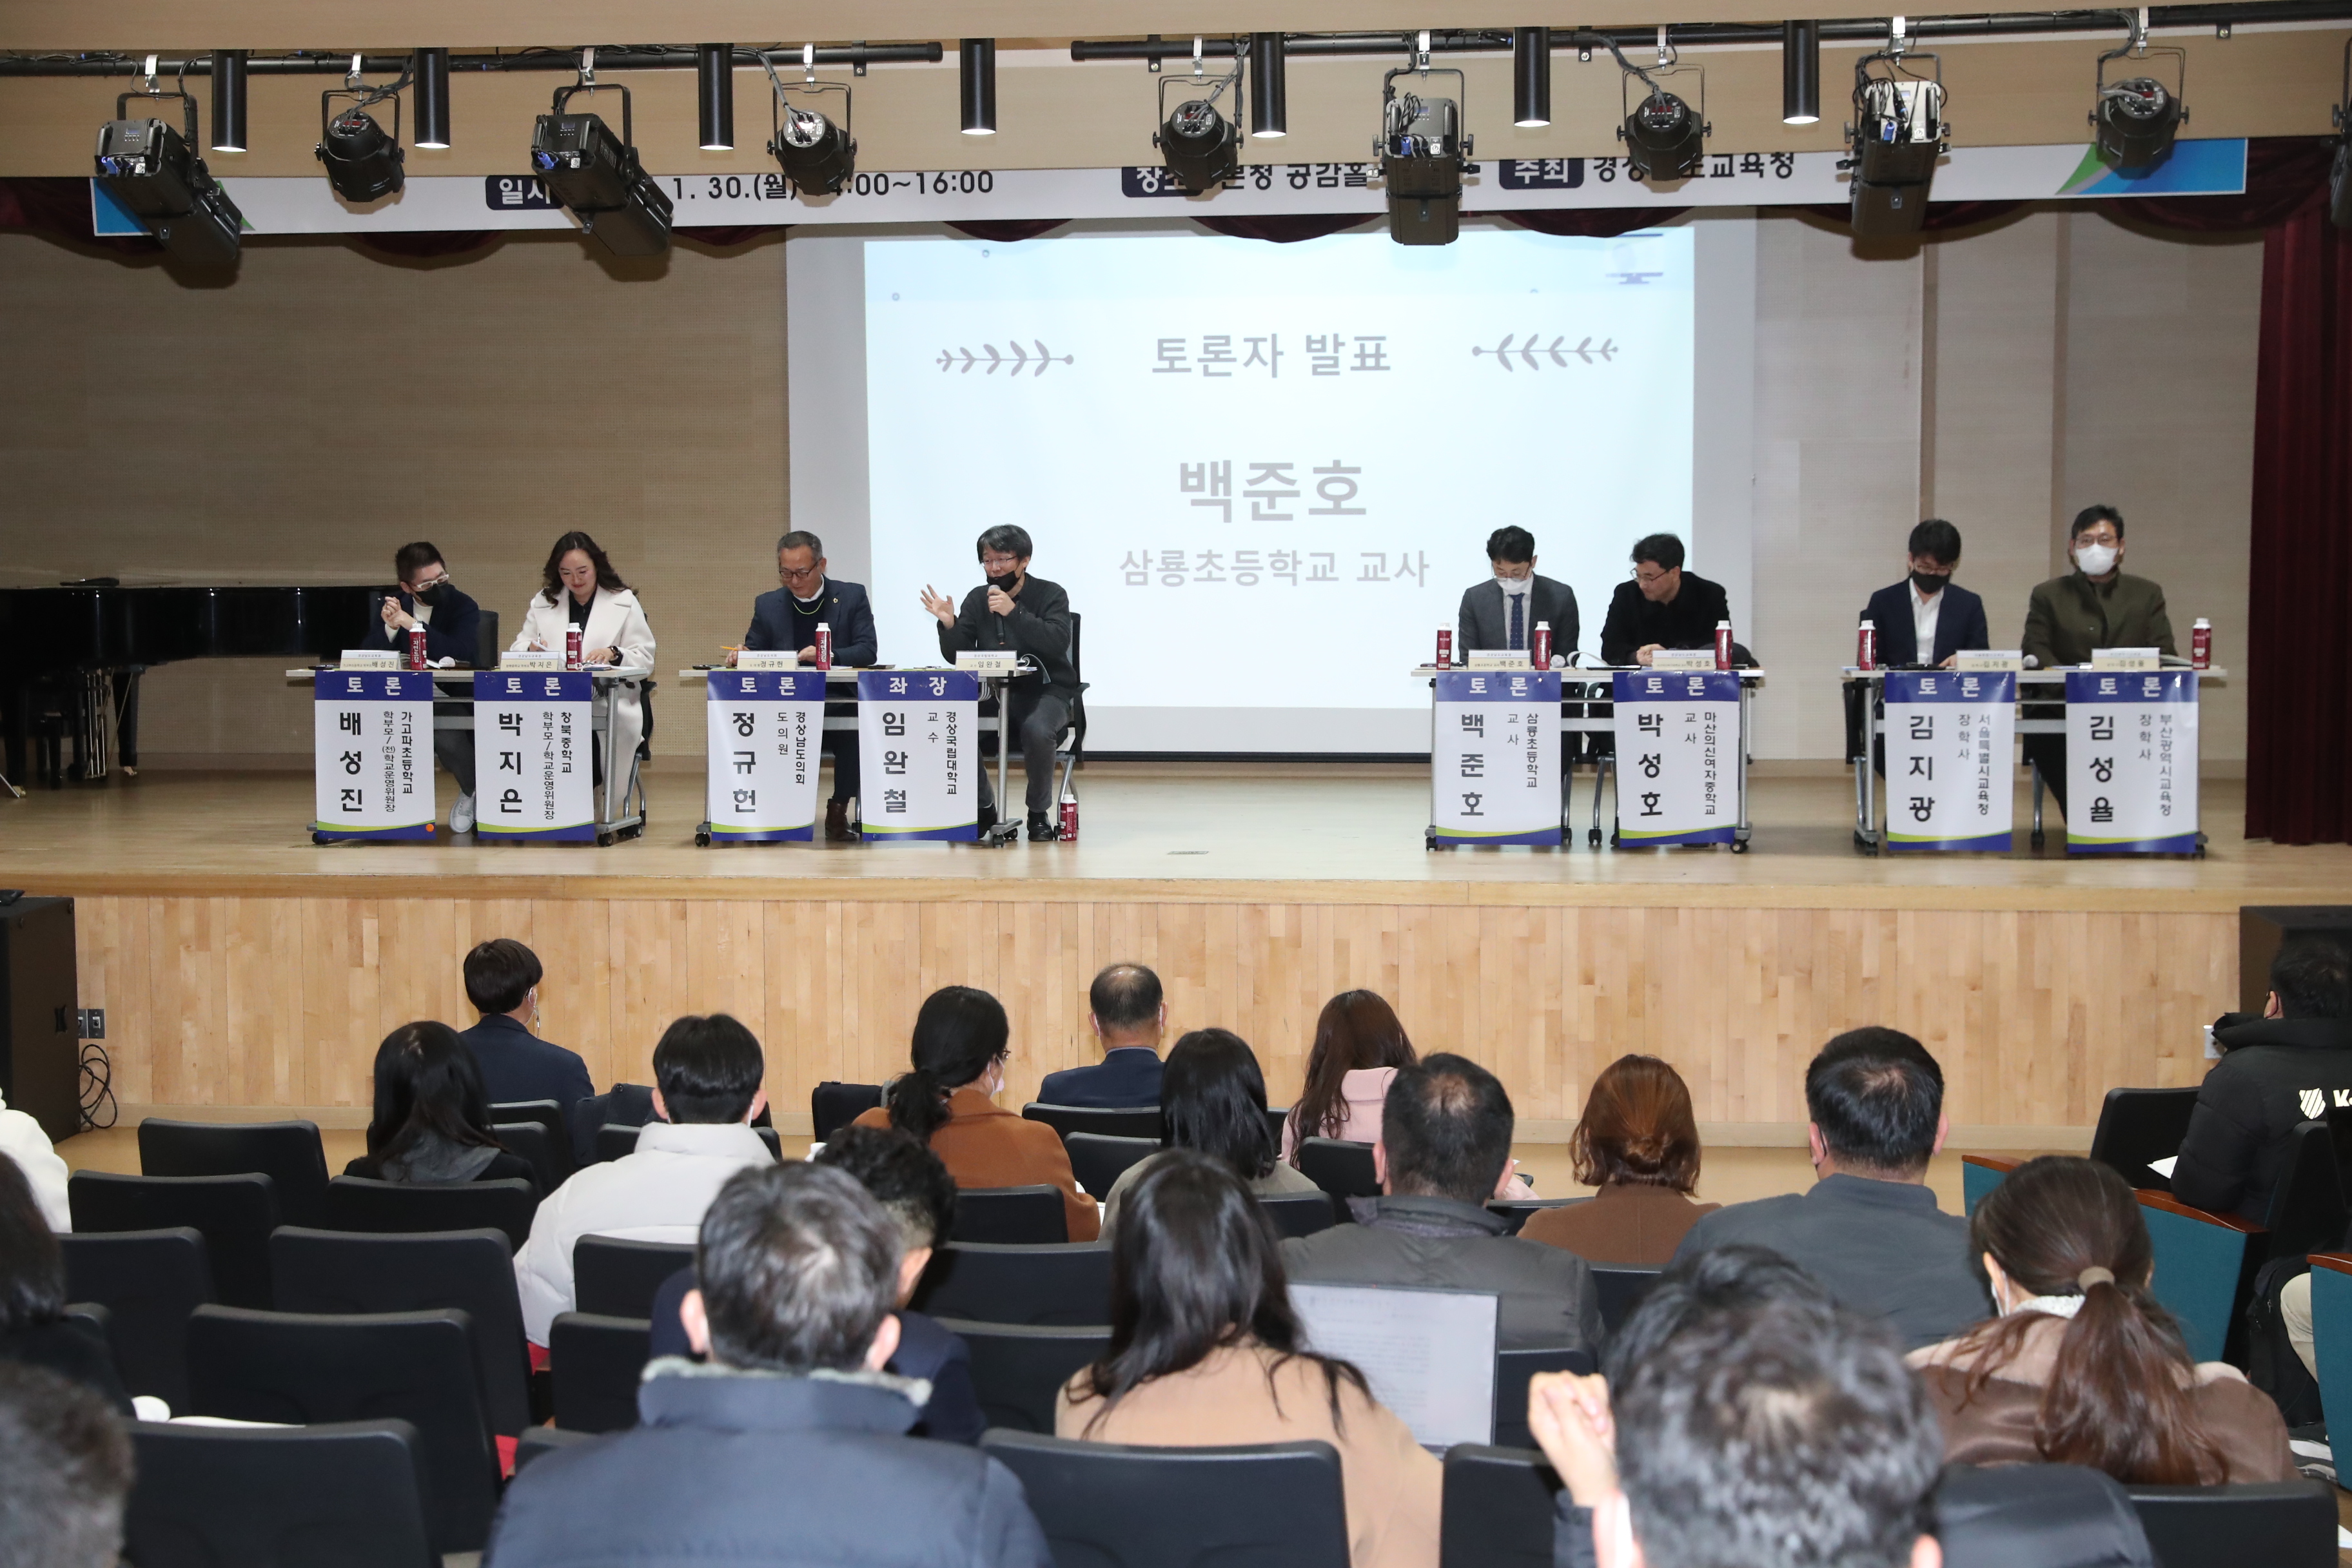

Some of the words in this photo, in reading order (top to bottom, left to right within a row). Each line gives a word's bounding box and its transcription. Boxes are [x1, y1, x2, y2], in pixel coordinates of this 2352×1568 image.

[499, 179, 551, 205] 일시
[673, 177, 696, 200] 1.
[708, 173, 798, 202] 30.(월)
[1286, 163, 1367, 190] 공감홀
[1514, 159, 1569, 184] 주최
[1152, 333, 1283, 378] 토론자
[1306, 333, 1390, 375] 발표
[1181, 460, 1366, 523] 백준호
[1119, 549, 1339, 587] 삼룡초등학교
[1357, 551, 1429, 587] 교사
[340, 712, 362, 812] 배성진
[382, 711, 395, 812] 학부모/(전)학교운영위원장
[402, 712, 413, 793] 가고파초등학교
[499, 714, 523, 812] 박지은
[562, 712, 572, 772] 창북중학교
[733, 713, 756, 812] 정규헌
[778, 712, 788, 754] 도의원
[796, 712, 806, 785] 경상남도의회
[883, 712, 908, 812] 임완철
[928, 712, 938, 743] 교수
[946, 712, 957, 794] 경상국립대학교
[1507, 714, 1519, 745] 교사
[1527, 714, 1538, 787] 삼룡초등학교
[1685, 713, 1696, 743] 교사
[1705, 712, 1716, 814] 마산의신여자중학교
[543, 712, 554, 819] 학부모/학교운영위원장
[1461, 714, 1484, 816] 백준호
[1638, 714, 1663, 816] 박성호
[1910, 716, 1935, 821] 김지광
[2090, 716, 2113, 822] 김성율
[2333, 1088, 2352, 1108] K
